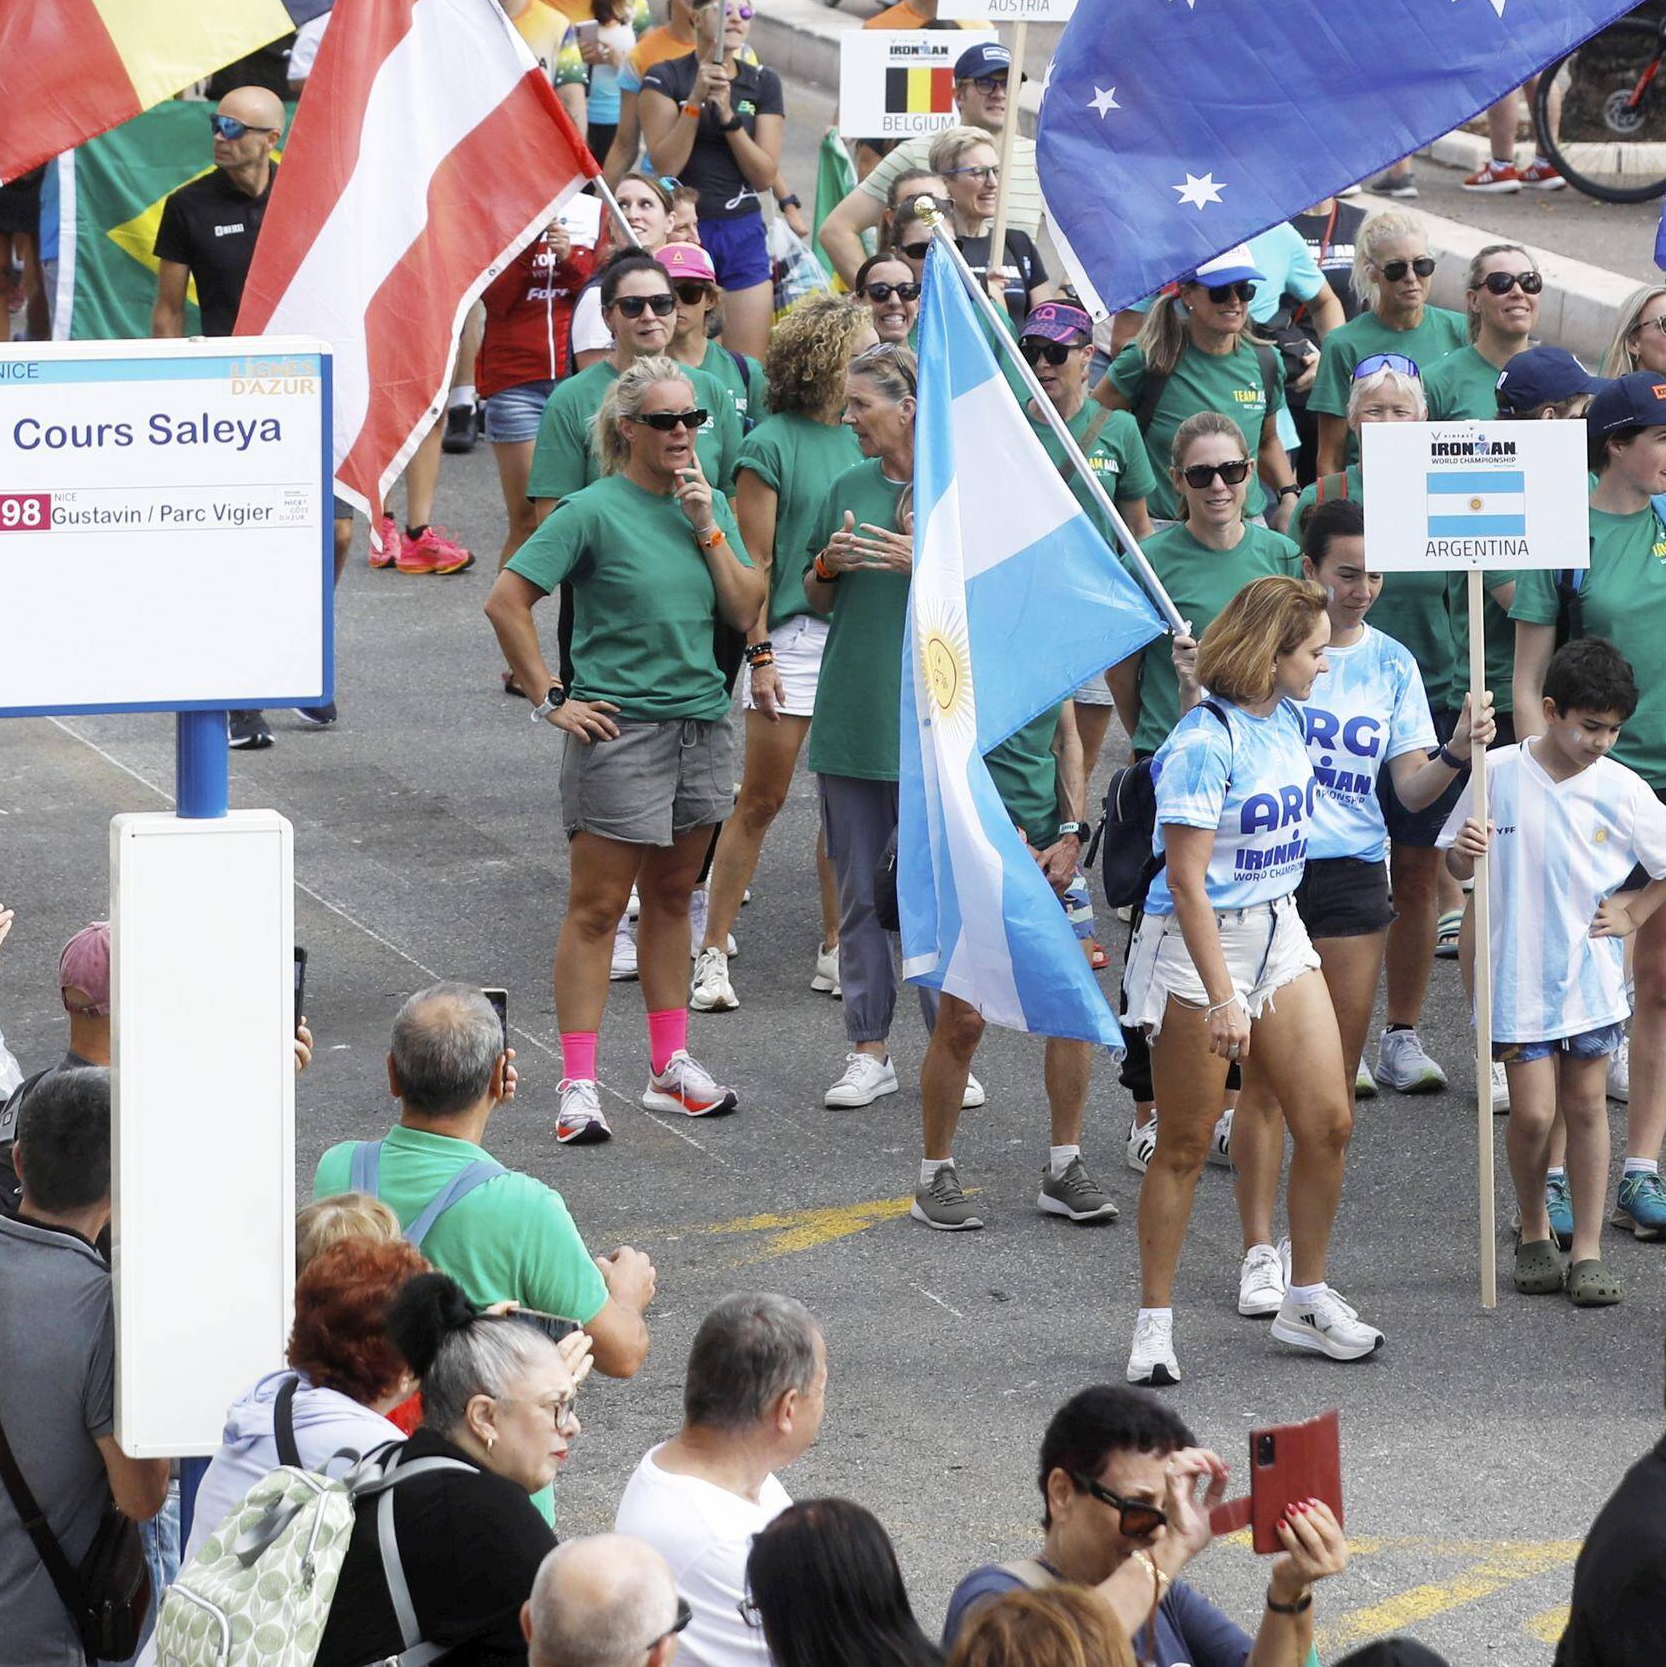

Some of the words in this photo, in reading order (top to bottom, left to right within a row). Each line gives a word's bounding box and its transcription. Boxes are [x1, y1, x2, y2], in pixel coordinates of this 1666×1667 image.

[883, 115, 955, 132] BELGIUM
[231, 379, 316, 395] D'AZUR
[1233, 390, 1256, 403] TEAM
[13, 417, 134, 450] Cours
[148, 413, 282, 451] Saleya
[1431, 434, 1516, 456] IRONMAN
[1460, 456, 1516, 464] CHAMPIONSHIP
[54, 492, 77, 502] NICE
[2, 498, 41, 527] 98
[51, 506, 141, 524] Gustavin
[160, 505, 205, 522] Parc
[213, 503, 274, 526] Vigier
[1425, 539, 1529, 557] ARGENTINA
[1303, 705, 1381, 758] RG
[1240, 776, 1318, 834] AR
[1496, 826, 1516, 835] YPF
[1234, 871, 1268, 882] WORD
